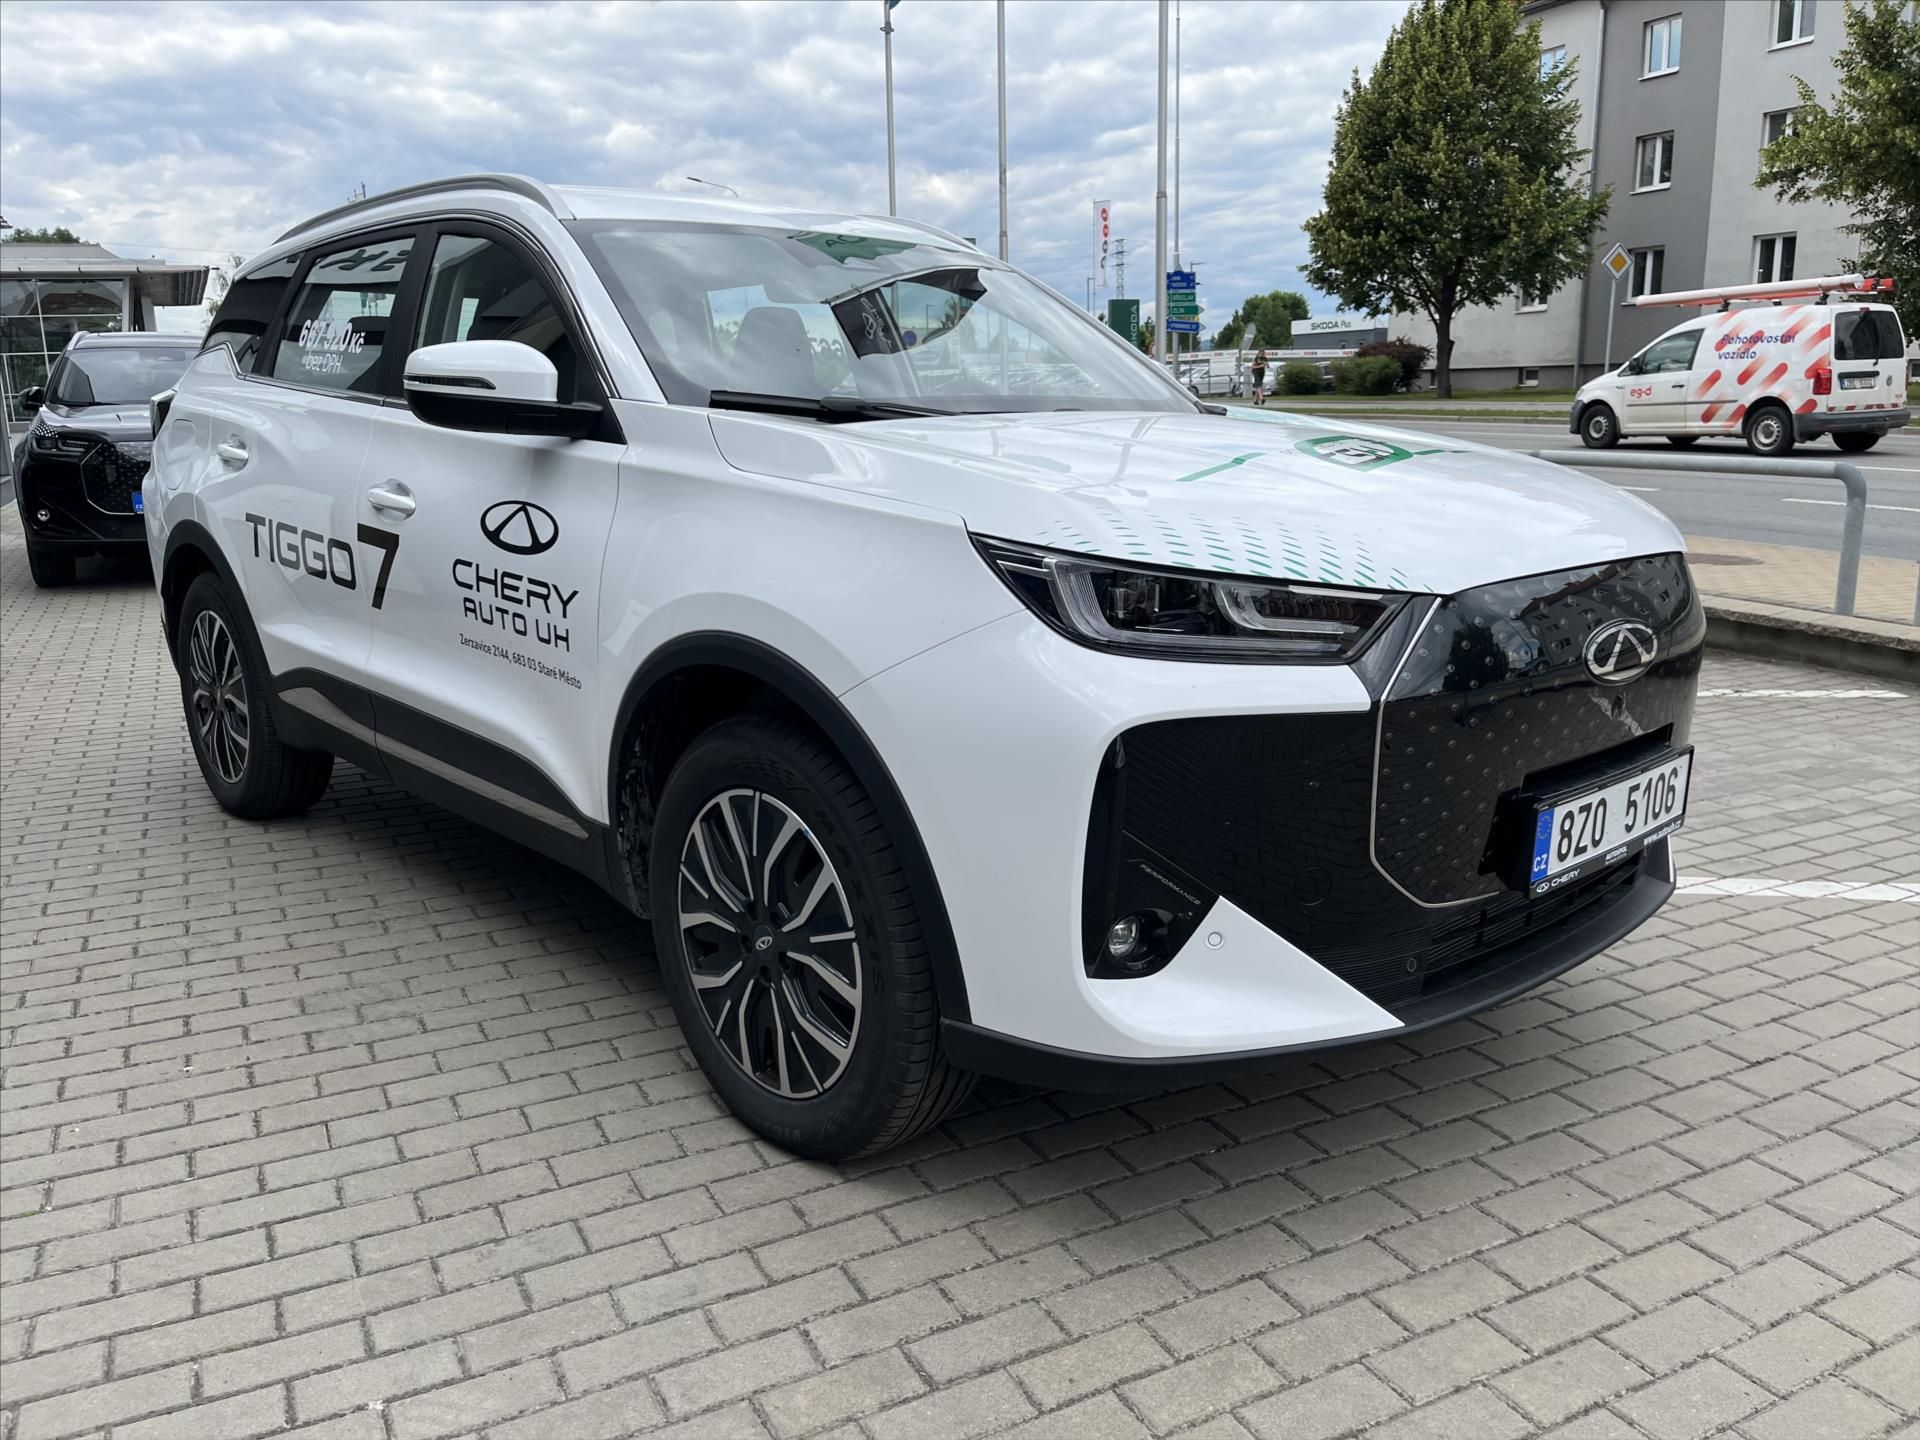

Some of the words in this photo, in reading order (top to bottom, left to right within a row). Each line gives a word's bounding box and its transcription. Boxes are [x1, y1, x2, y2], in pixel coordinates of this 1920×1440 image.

[305, 351, 323, 371] bez
[322, 354, 343, 374] DPH
[348, 332, 366, 353] Kč
[1717, 350, 1757, 359] vozidlo
[453, 558, 580, 619] CHERY
[463, 596, 527, 637] AUTO
[535, 618, 570, 653] UH
[459, 632, 492, 655] Zerzavice
[527, 657, 537, 672] 03
[537, 661, 558, 680] Staré
[558, 669, 582, 690] Město
[1556, 797, 1608, 863] 8Z0
[1624, 766, 1679, 834] 5106
[1533, 852, 1547, 873] CZ
[1551, 868, 1581, 888] CHERY
[812, 807, 886, 999] MAXXIS
[1140, 863, 1201, 905] PERFORMANCE
